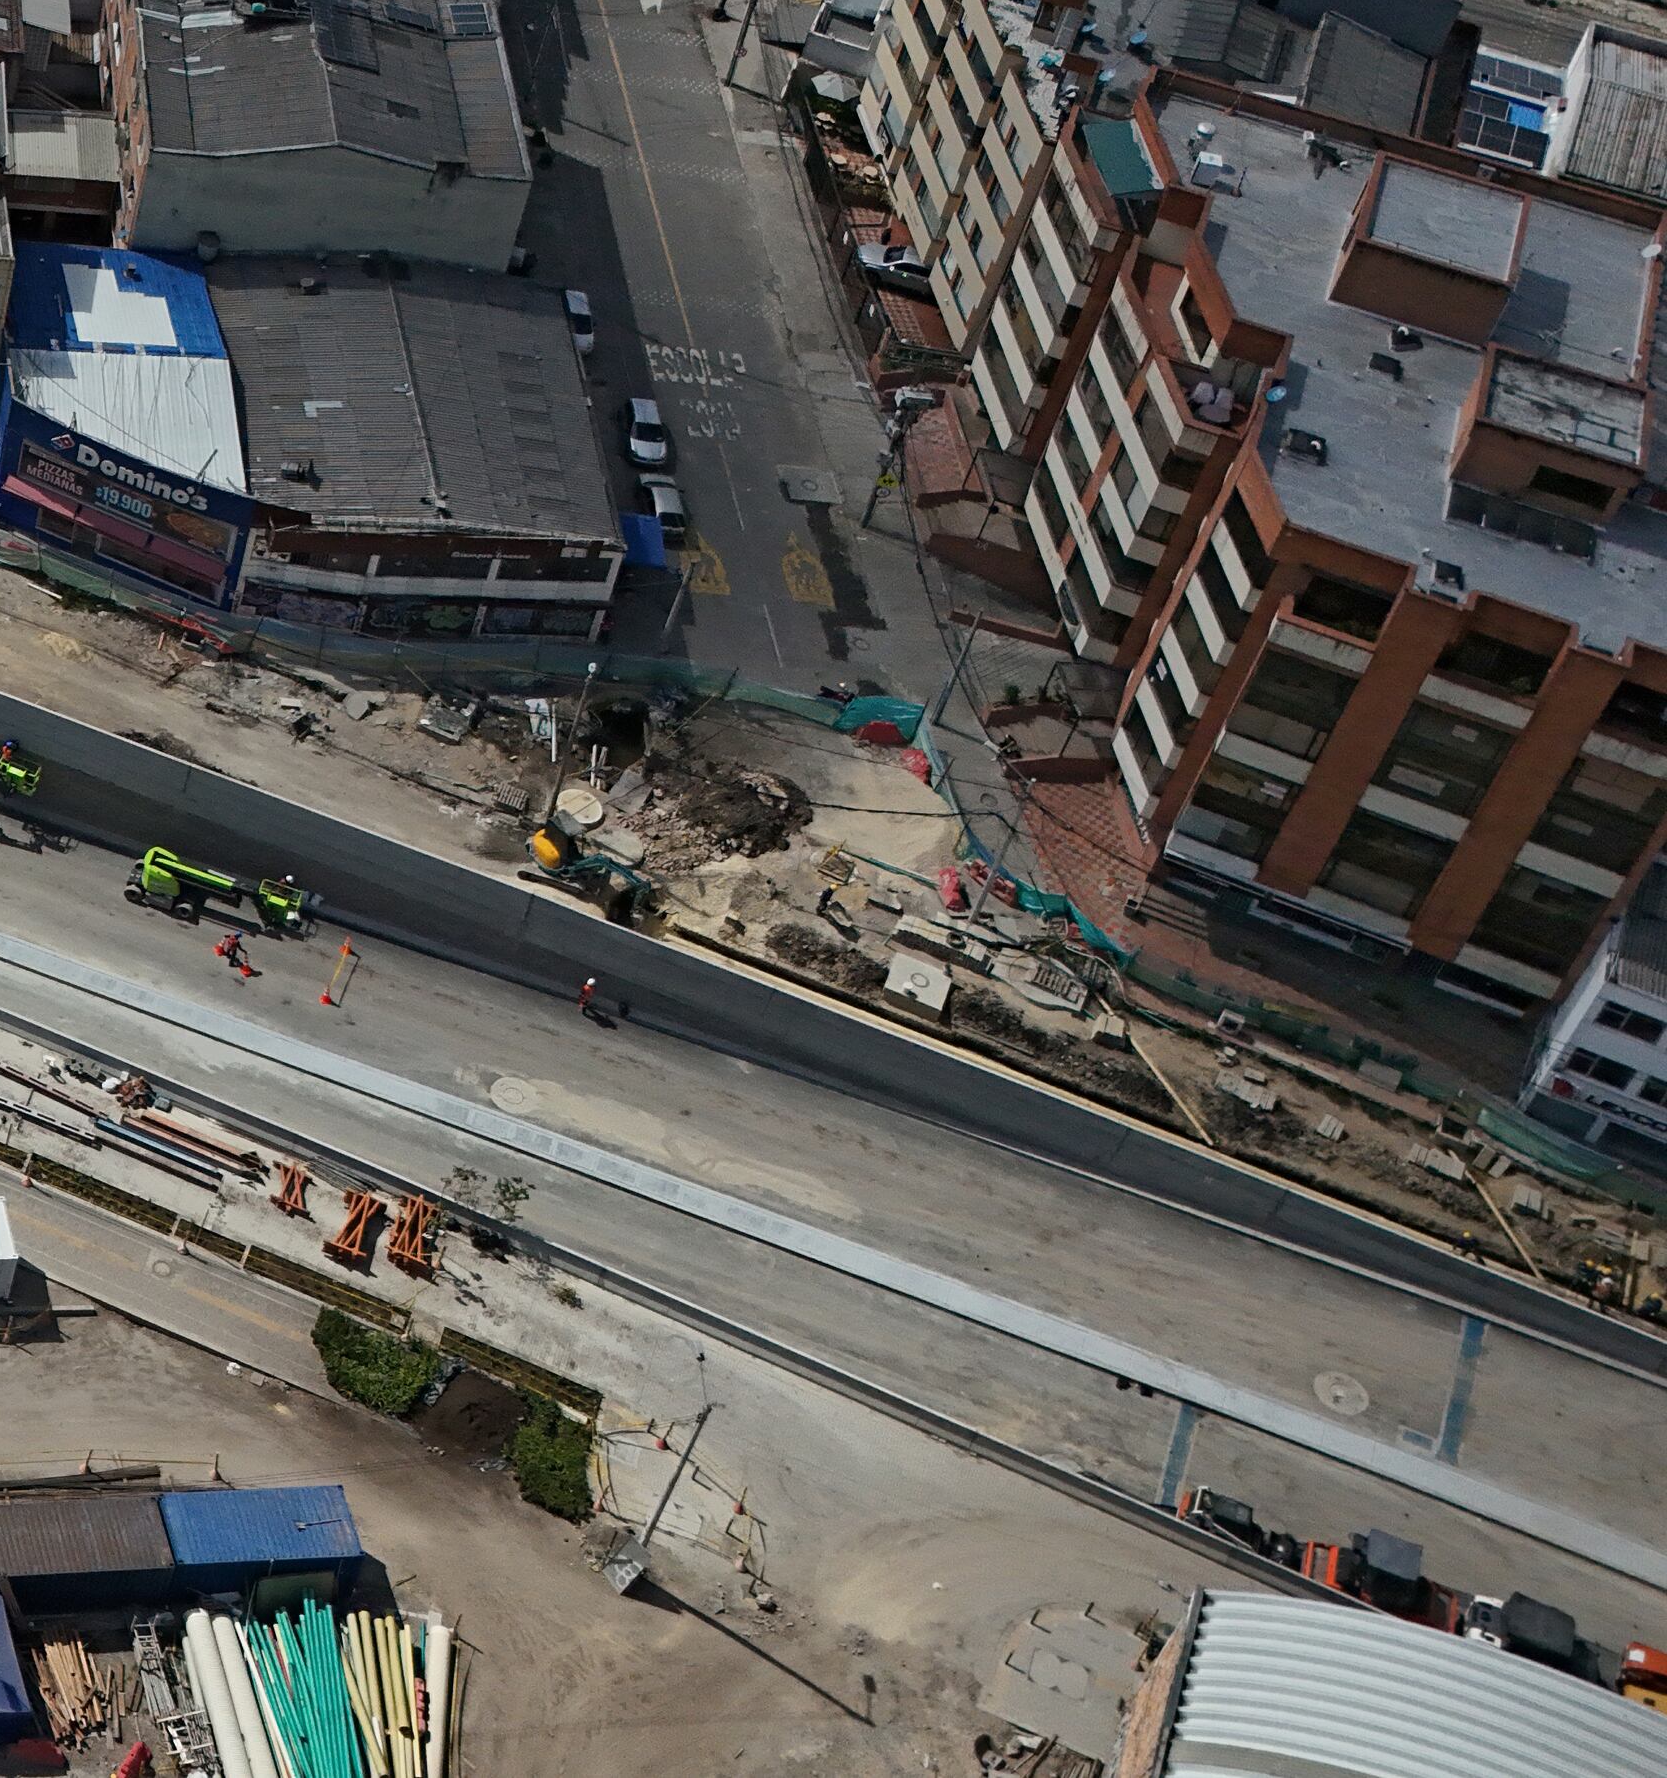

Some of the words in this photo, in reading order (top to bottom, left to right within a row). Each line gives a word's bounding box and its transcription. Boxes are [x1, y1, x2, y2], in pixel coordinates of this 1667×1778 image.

[26, 464, 83, 496] MEDIANAS
[38, 459, 76, 483] PIZZAS
[76, 443, 209, 511] Domino's
